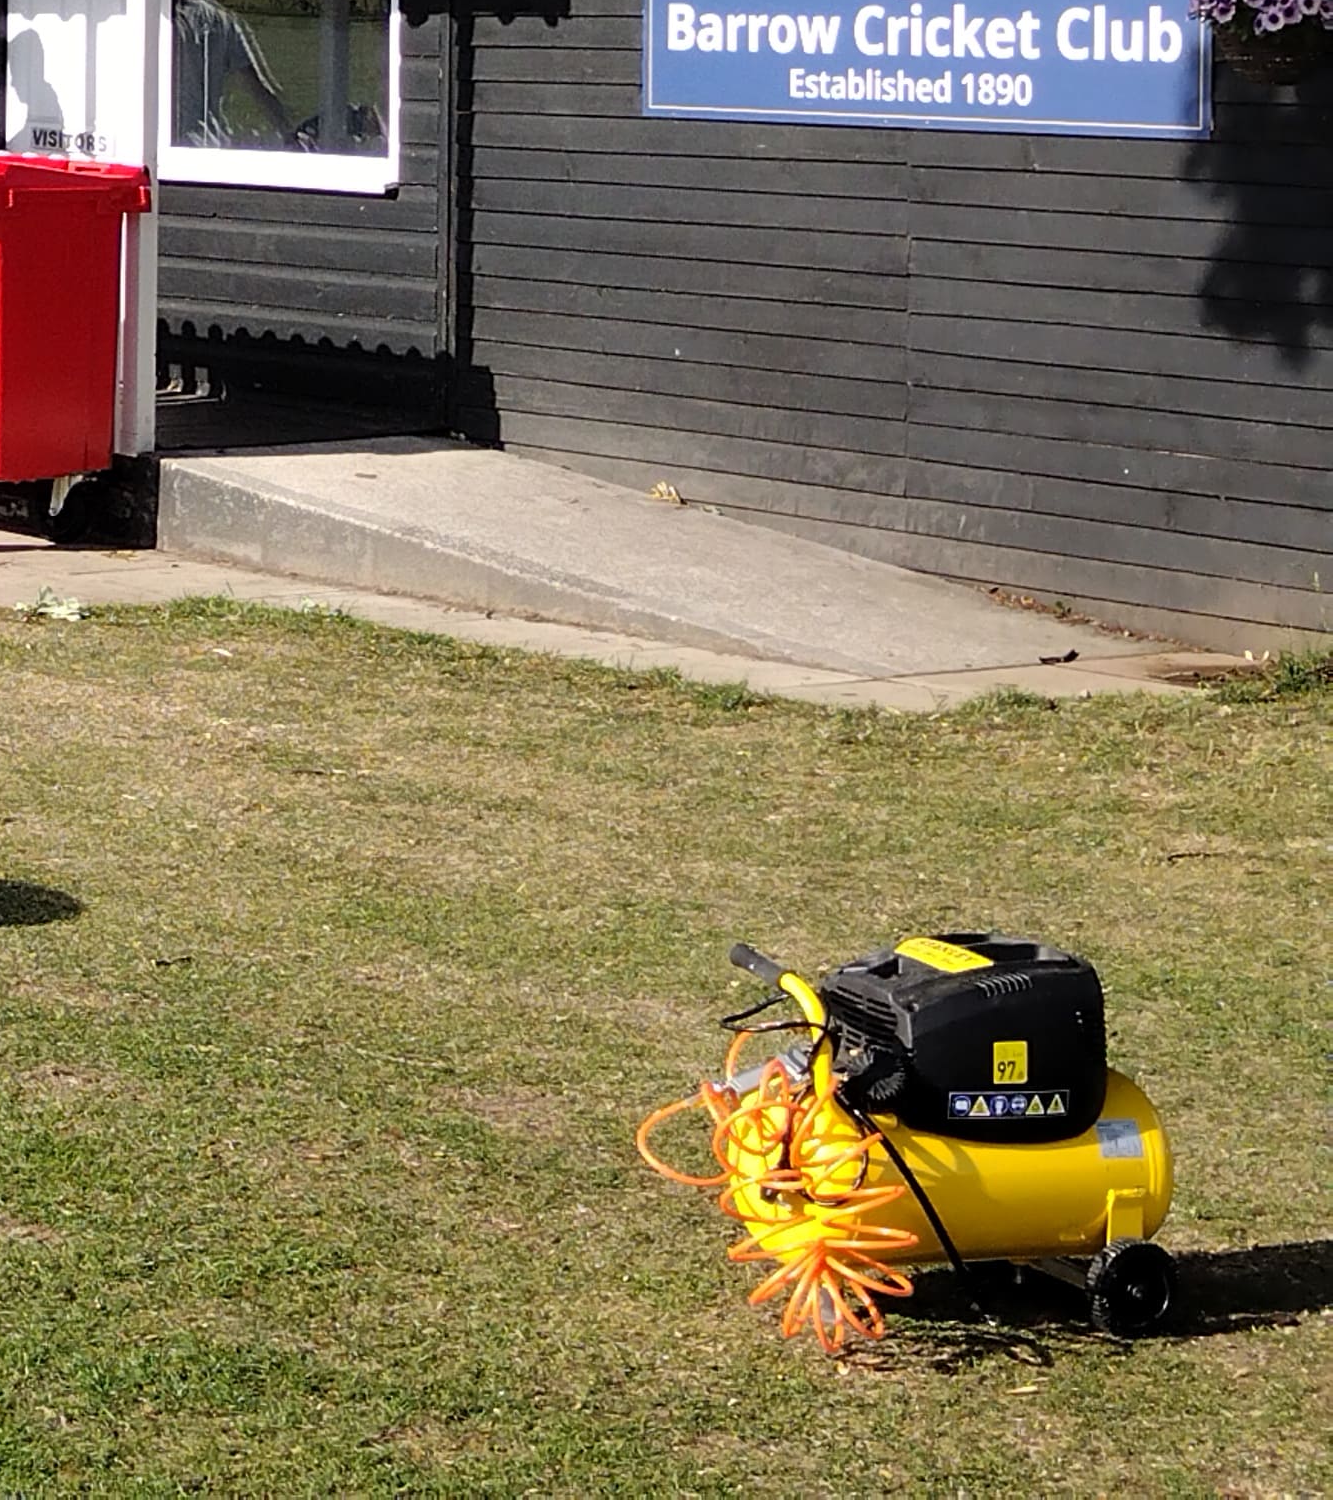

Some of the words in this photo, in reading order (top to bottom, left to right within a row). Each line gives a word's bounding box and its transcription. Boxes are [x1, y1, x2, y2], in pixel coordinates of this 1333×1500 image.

[667, 3, 841, 55] Barrow
[853, 4, 1041, 61] Cricket
[1056, 6, 1183, 64] Club
[789, 68, 953, 105] Established
[961, 72, 1033, 106] 1890
[32, 129, 107, 152] VISITORS
[997, 1060, 1017, 1081] 97
